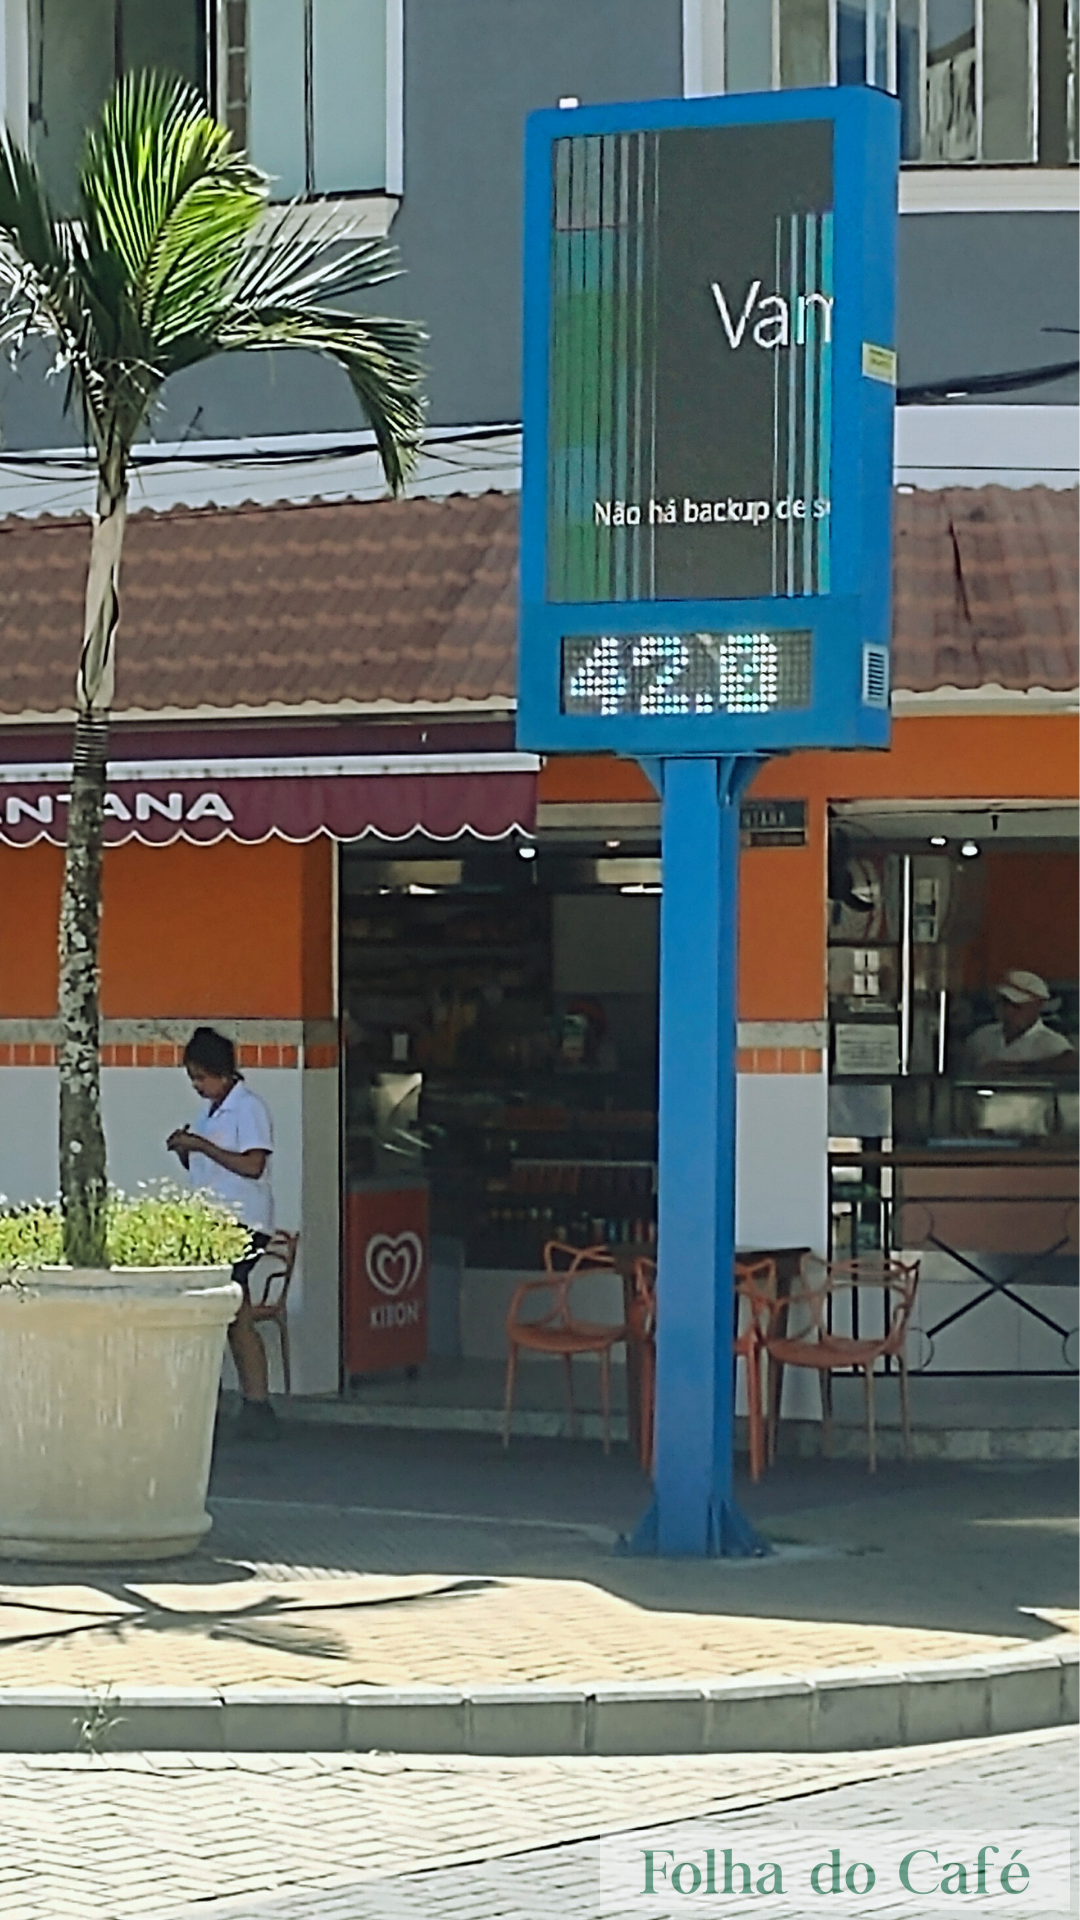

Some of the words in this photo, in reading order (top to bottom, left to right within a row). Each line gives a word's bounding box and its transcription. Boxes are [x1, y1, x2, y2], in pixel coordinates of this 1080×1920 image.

[594, 500, 641, 526] Não
[650, 497, 677, 524] há
[684, 497, 770, 527] backup
[776, 496, 807, 519] de
[570, 633, 778, 716] 42.0
